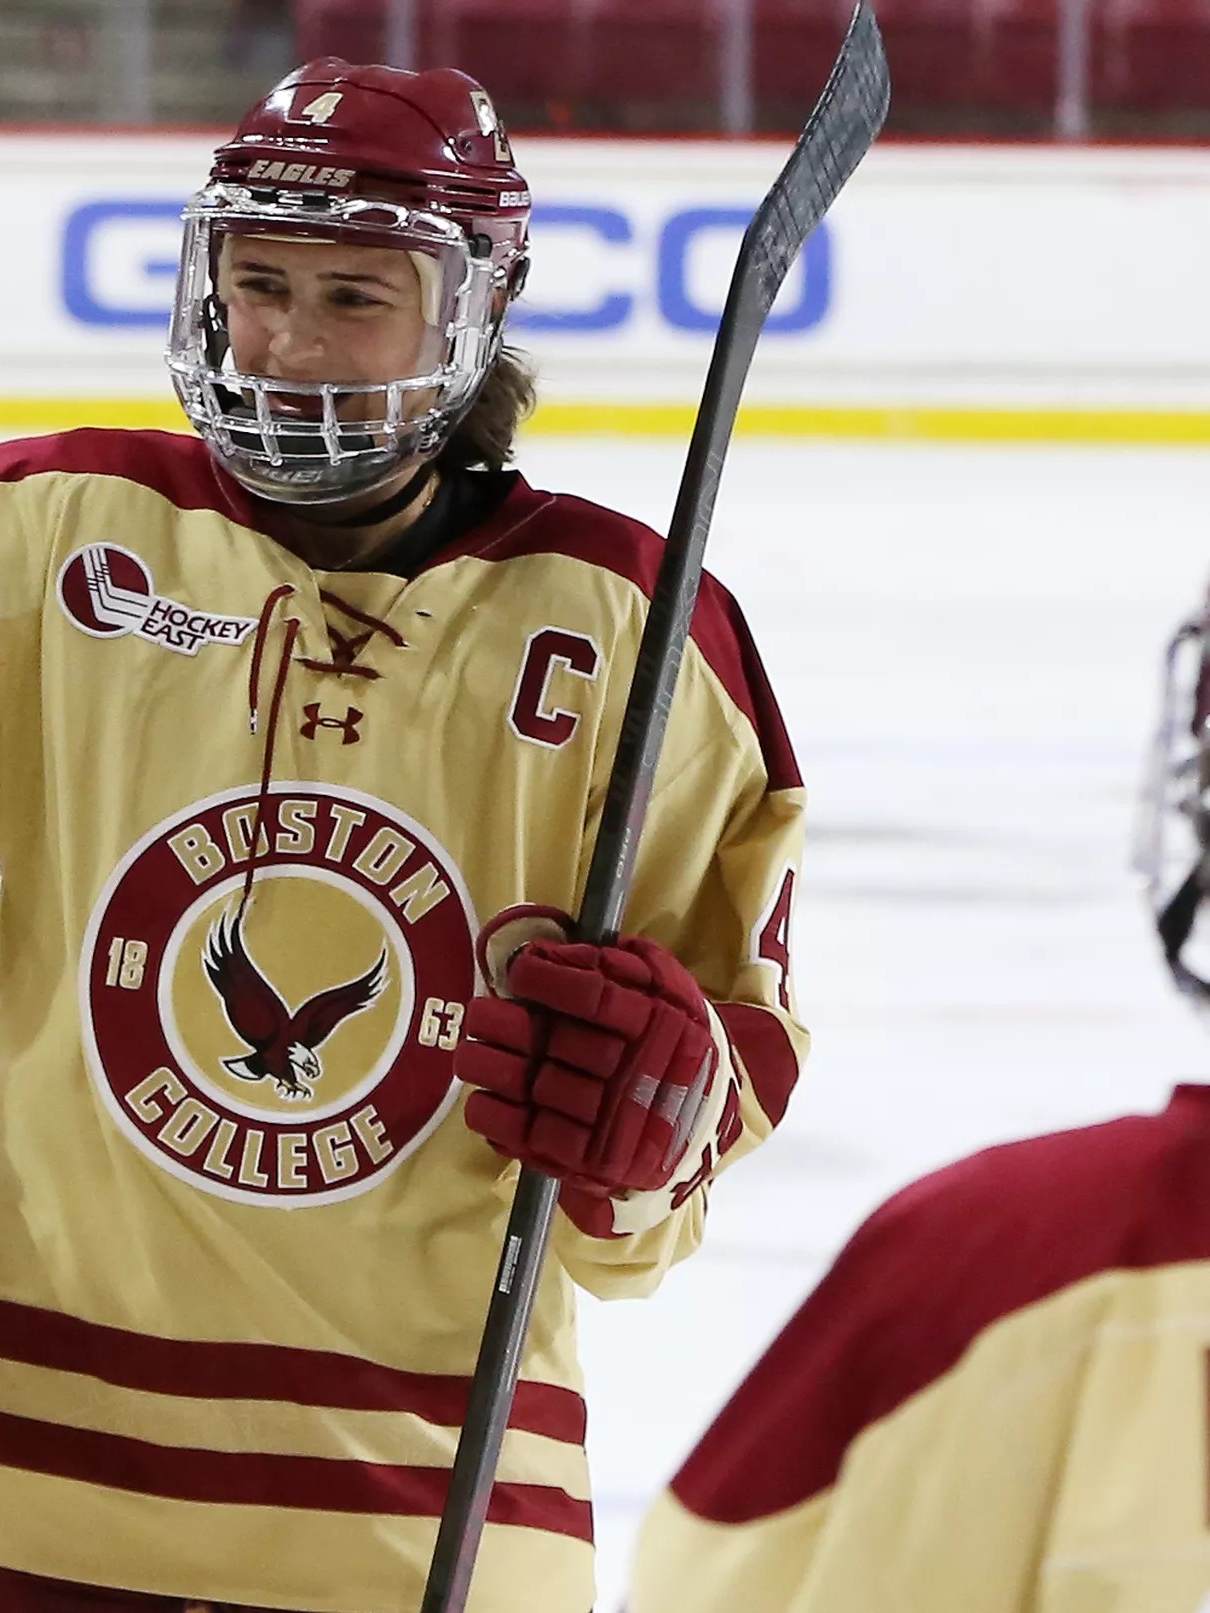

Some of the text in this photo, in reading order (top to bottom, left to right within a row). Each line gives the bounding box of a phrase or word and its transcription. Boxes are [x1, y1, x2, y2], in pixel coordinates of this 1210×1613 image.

[302, 91, 344, 124] 4
[247, 159, 357, 188] EAGLES
[61, 199, 835, 334] GCO
[141, 619, 205, 651] EAST
[149, 600, 250, 641] HOCKEY
[506, 624, 602, 750] C
[166, 799, 451, 925] BOSTON
[105, 936, 149, 990] 18
[417, 996, 466, 1051] 63
[124, 1066, 394, 1190] COLLEGE
